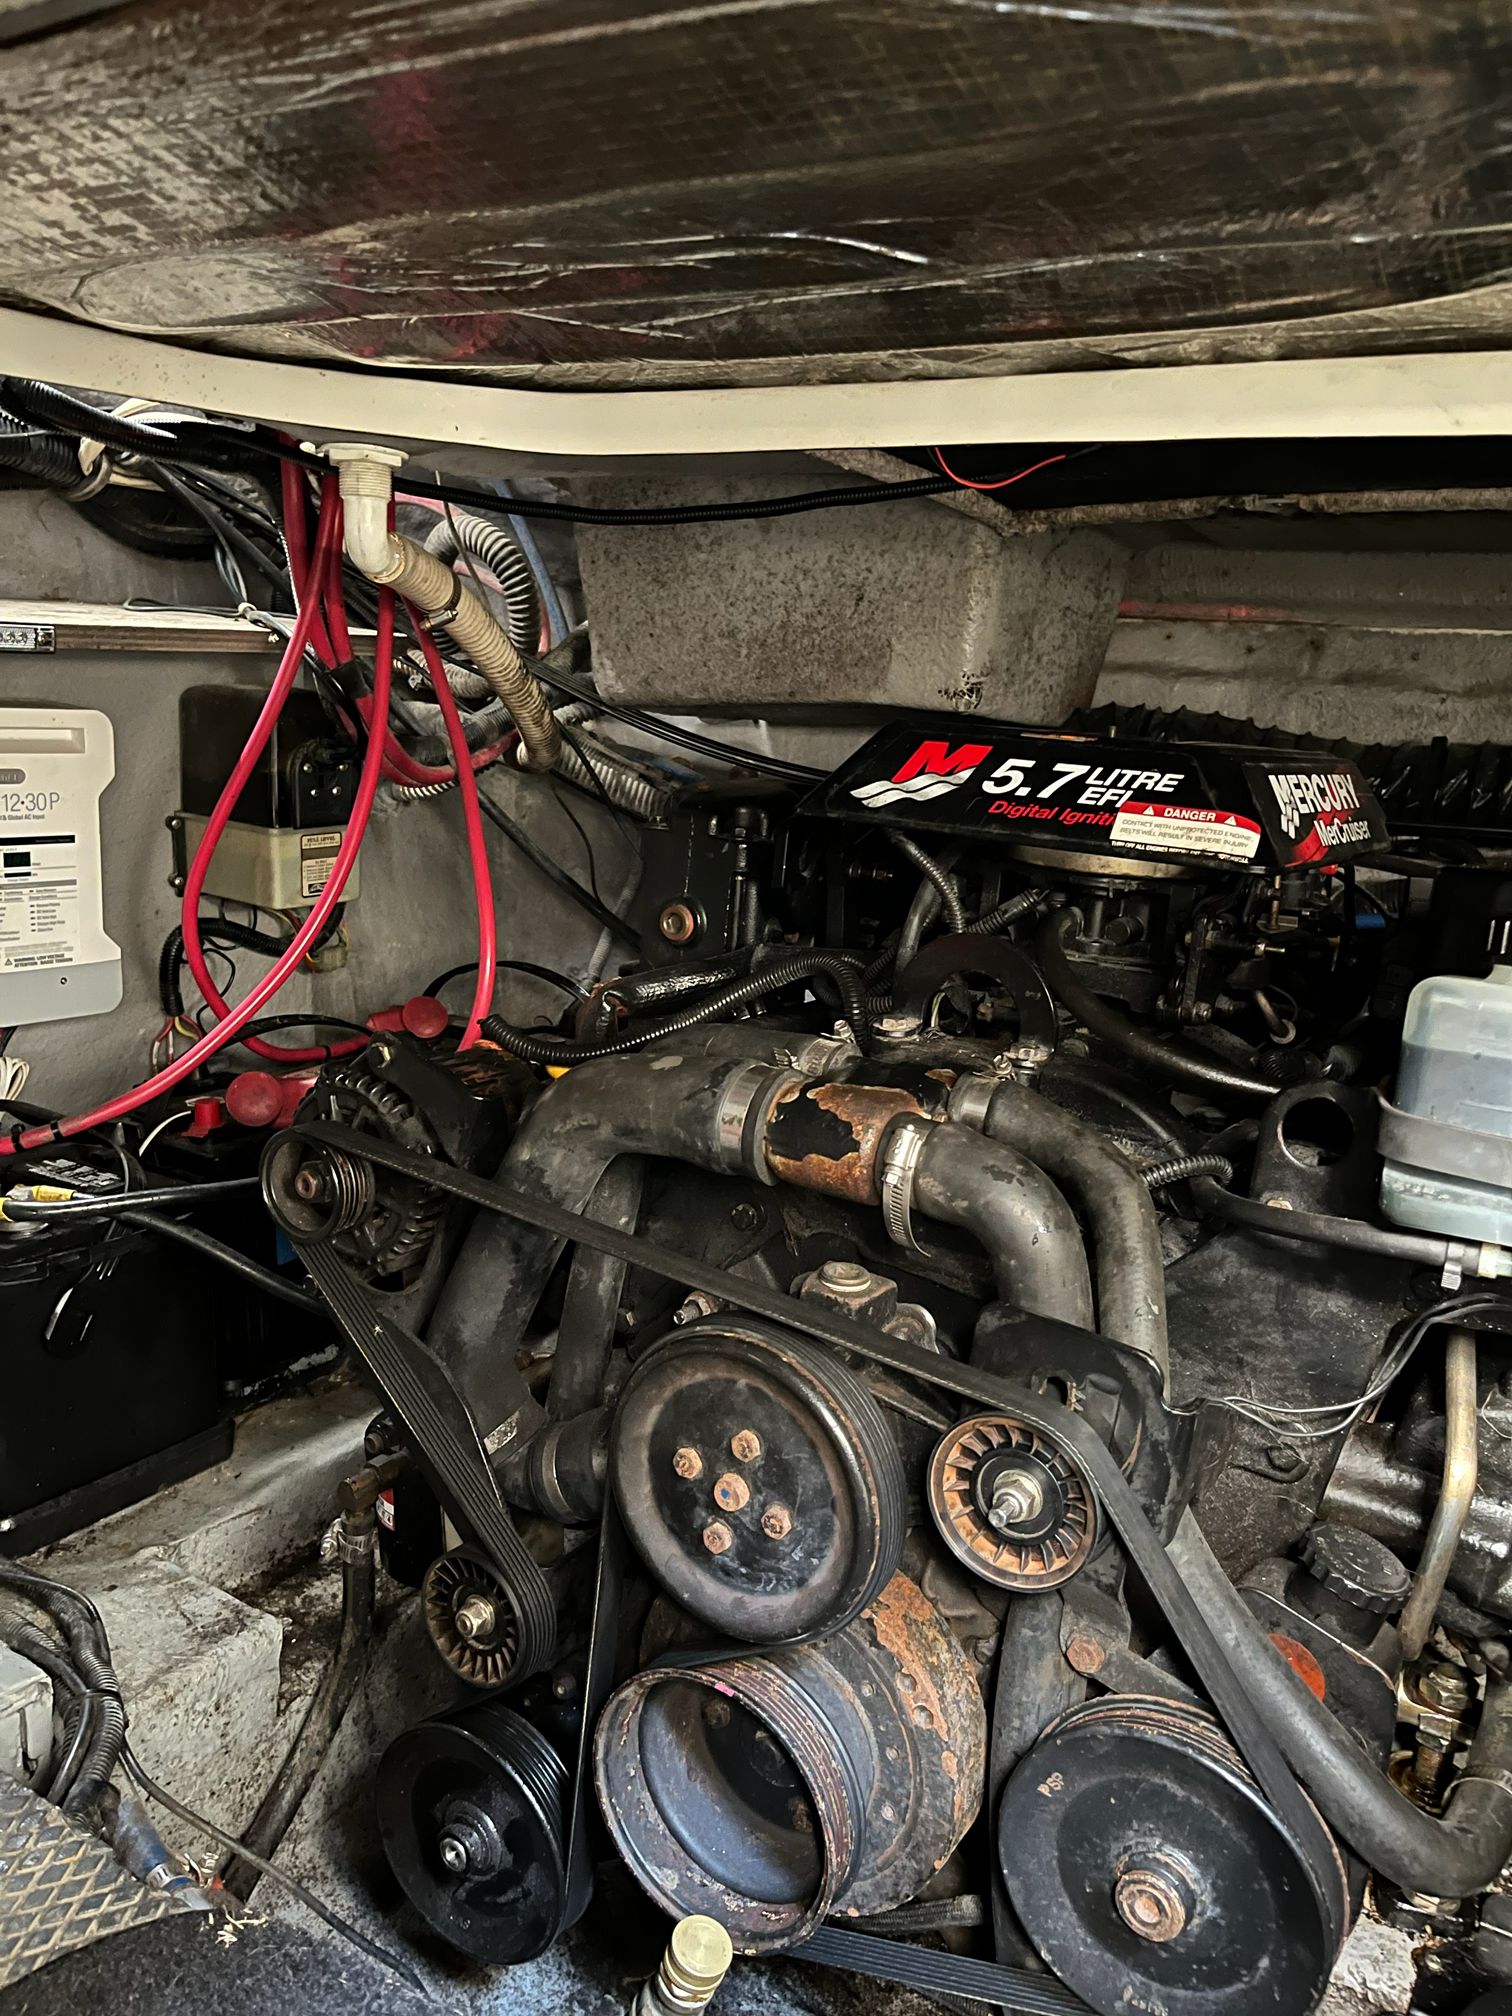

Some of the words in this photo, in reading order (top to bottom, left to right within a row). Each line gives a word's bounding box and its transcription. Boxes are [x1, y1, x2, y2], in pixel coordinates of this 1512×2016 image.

[982, 758, 1091, 799] 5.7
[1085, 767, 1185, 793] LITRE
[1076, 786, 1134, 808] EFI
[1268, 774, 1360, 814] MERCURY
[988, 800, 1059, 819] Digital
[1058, 808, 1117, 826] Igniti
[1164, 807, 1216, 822] DANGER
[1119, 827, 1141, 835] BELTS
[1157, 831, 1185, 840] RESULT
[1222, 839, 1249, 848] INJURY
[1122, 819, 1153, 828] CONTACT
[1153, 822, 1172, 830] WITH
[1172, 825, 1224, 836] UNPROTECTED
[1313, 817, 1371, 847] MerCruiser
